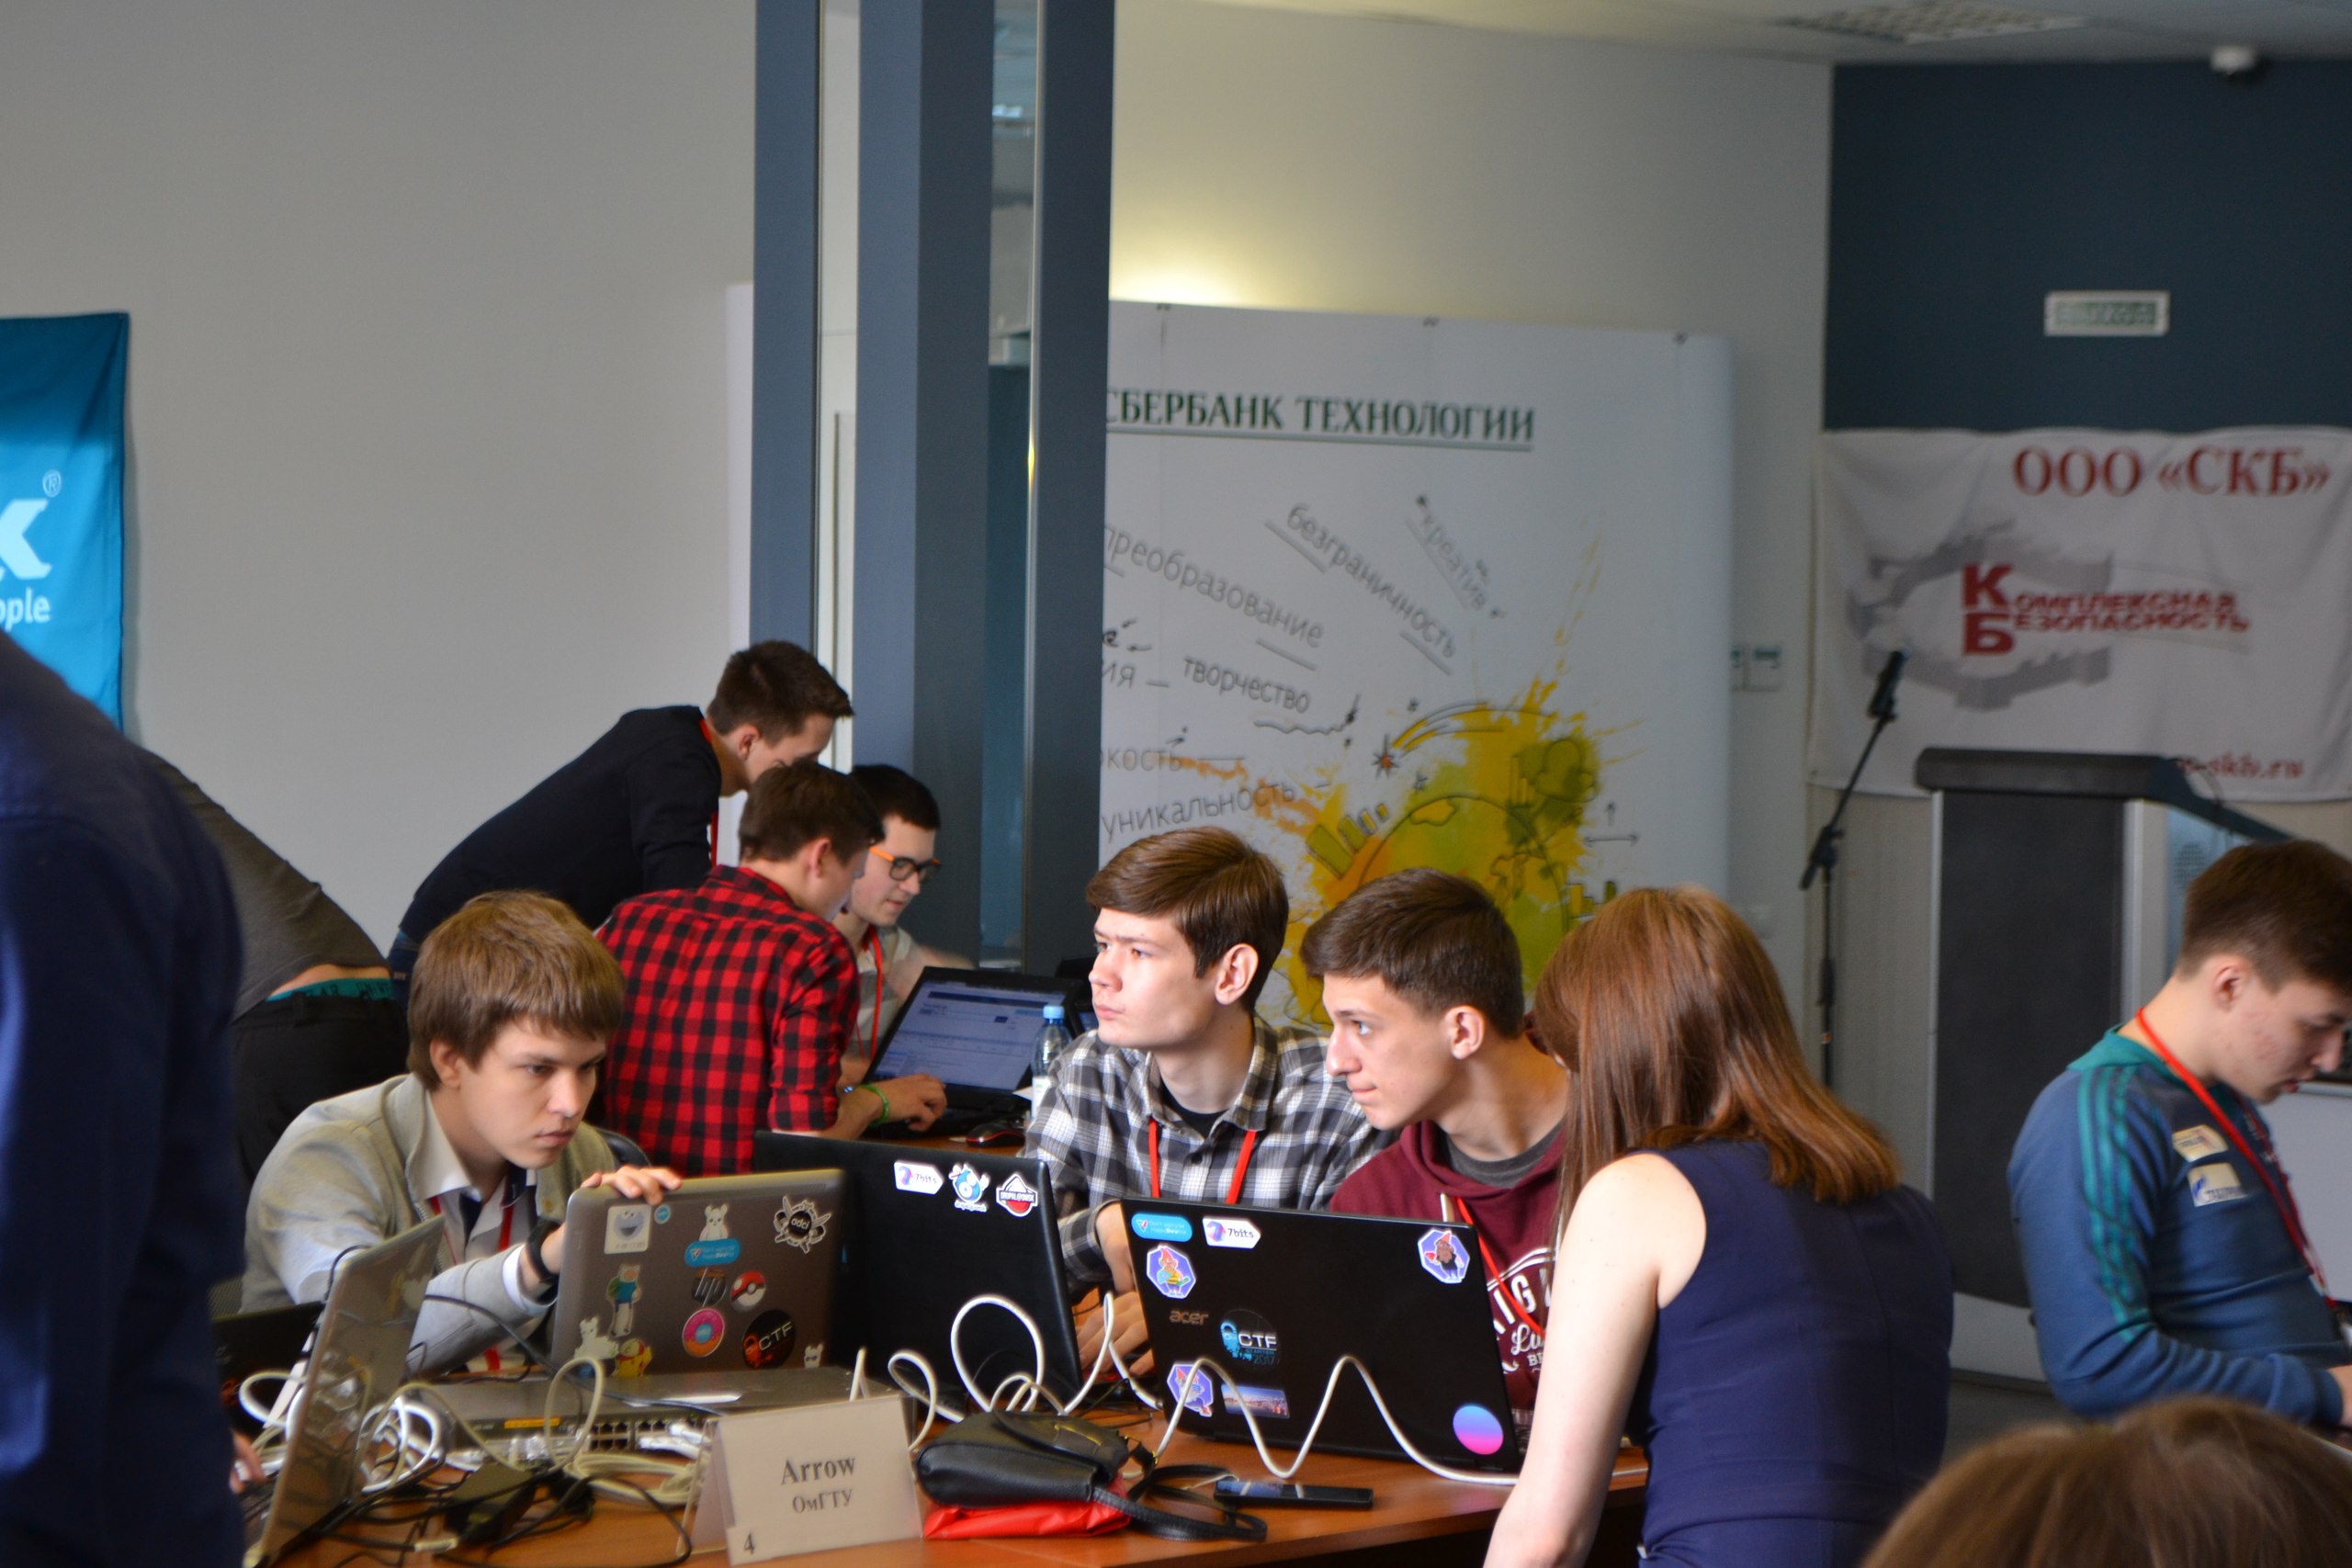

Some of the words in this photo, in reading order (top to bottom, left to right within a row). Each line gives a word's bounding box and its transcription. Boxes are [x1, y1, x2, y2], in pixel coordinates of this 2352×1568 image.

[1296, 397, 1535, 443] ТЕХНОЛОГИИ
[2013, 446, 2143, 497] ООО
[2158, 445, 2331, 497] «СКБ»
[1287, 503, 1456, 659] безграничность
[1183, 656, 1311, 714] творчество
[1101, 749, 1182, 772] кость
[1102, 783, 1295, 843] уникальность
[1227, 1227, 1255, 1239] 7bits
[1170, 1309, 1209, 1325] acer
[759, 1321, 793, 1352] CTF
[1238, 1332, 1277, 1348] CTF
[781, 1457, 855, 1485] Arrow
[792, 1488, 853, 1514] ОмГТУ
[743, 1532, 756, 1555] 4
